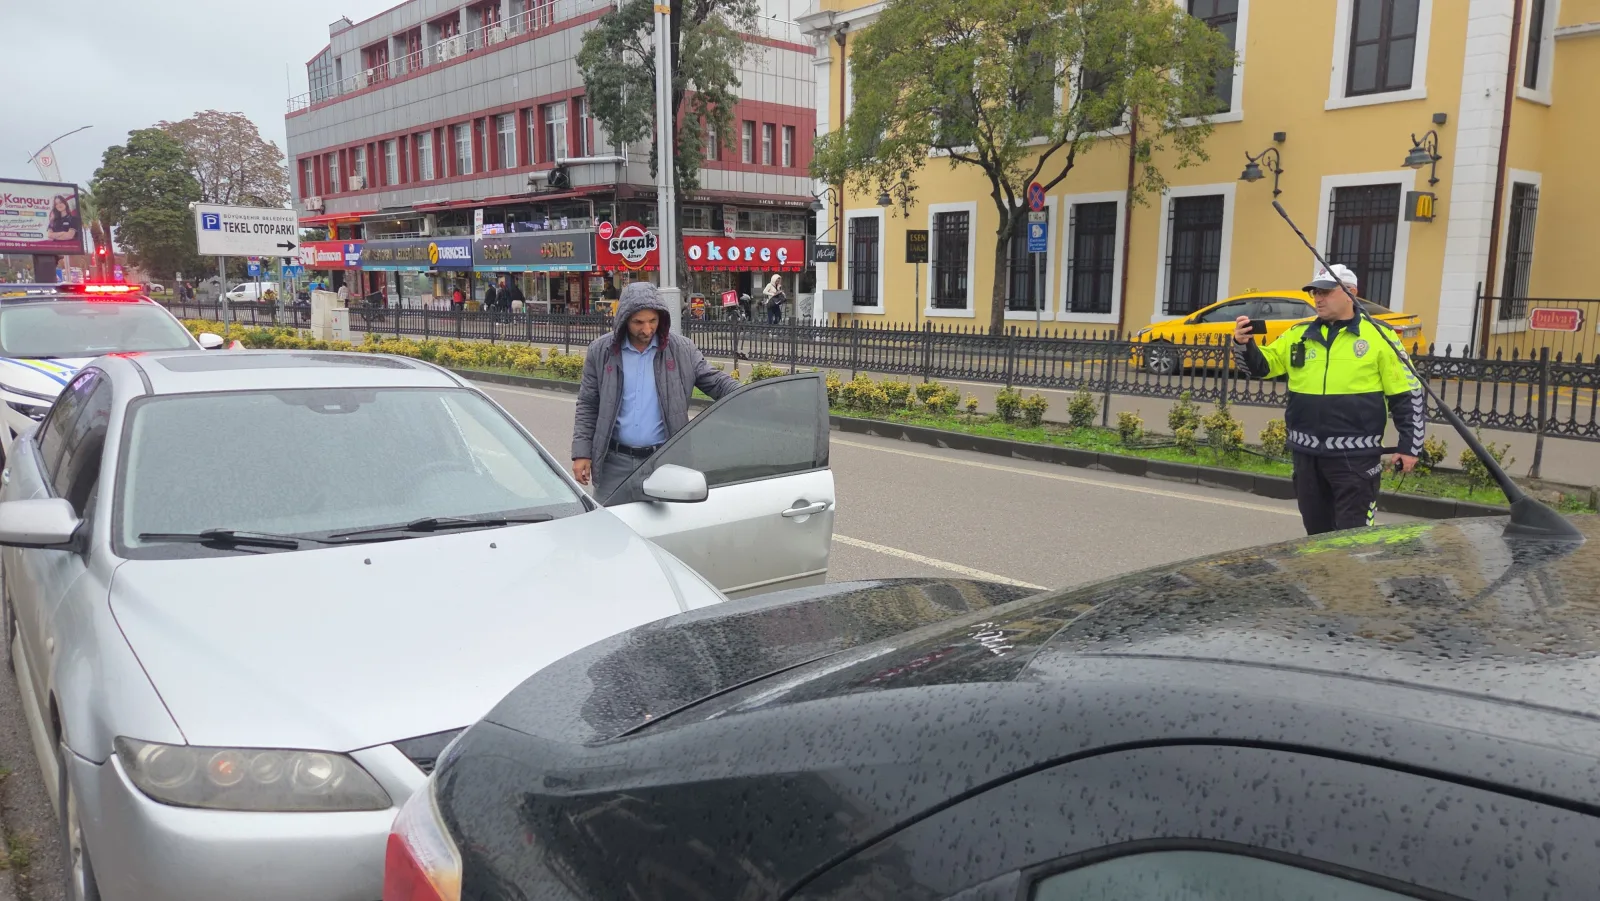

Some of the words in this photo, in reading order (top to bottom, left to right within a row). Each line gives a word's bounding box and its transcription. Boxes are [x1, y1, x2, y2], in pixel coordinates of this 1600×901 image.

[4, 193, 50, 208] Kanguru
[223, 213, 260, 221] BÜYÜKŞEHİR
[223, 222, 251, 234] TEKEL
[253, 224, 295, 236] OTOPARKI
[611, 235, 655, 254] saçak
[910, 234, 926, 242] ESEN
[437, 246, 471, 260] TURKCELL
[541, 240, 575, 258] DÖNER
[688, 241, 788, 266] okoreç
[1536, 310, 1575, 324] bulvar
